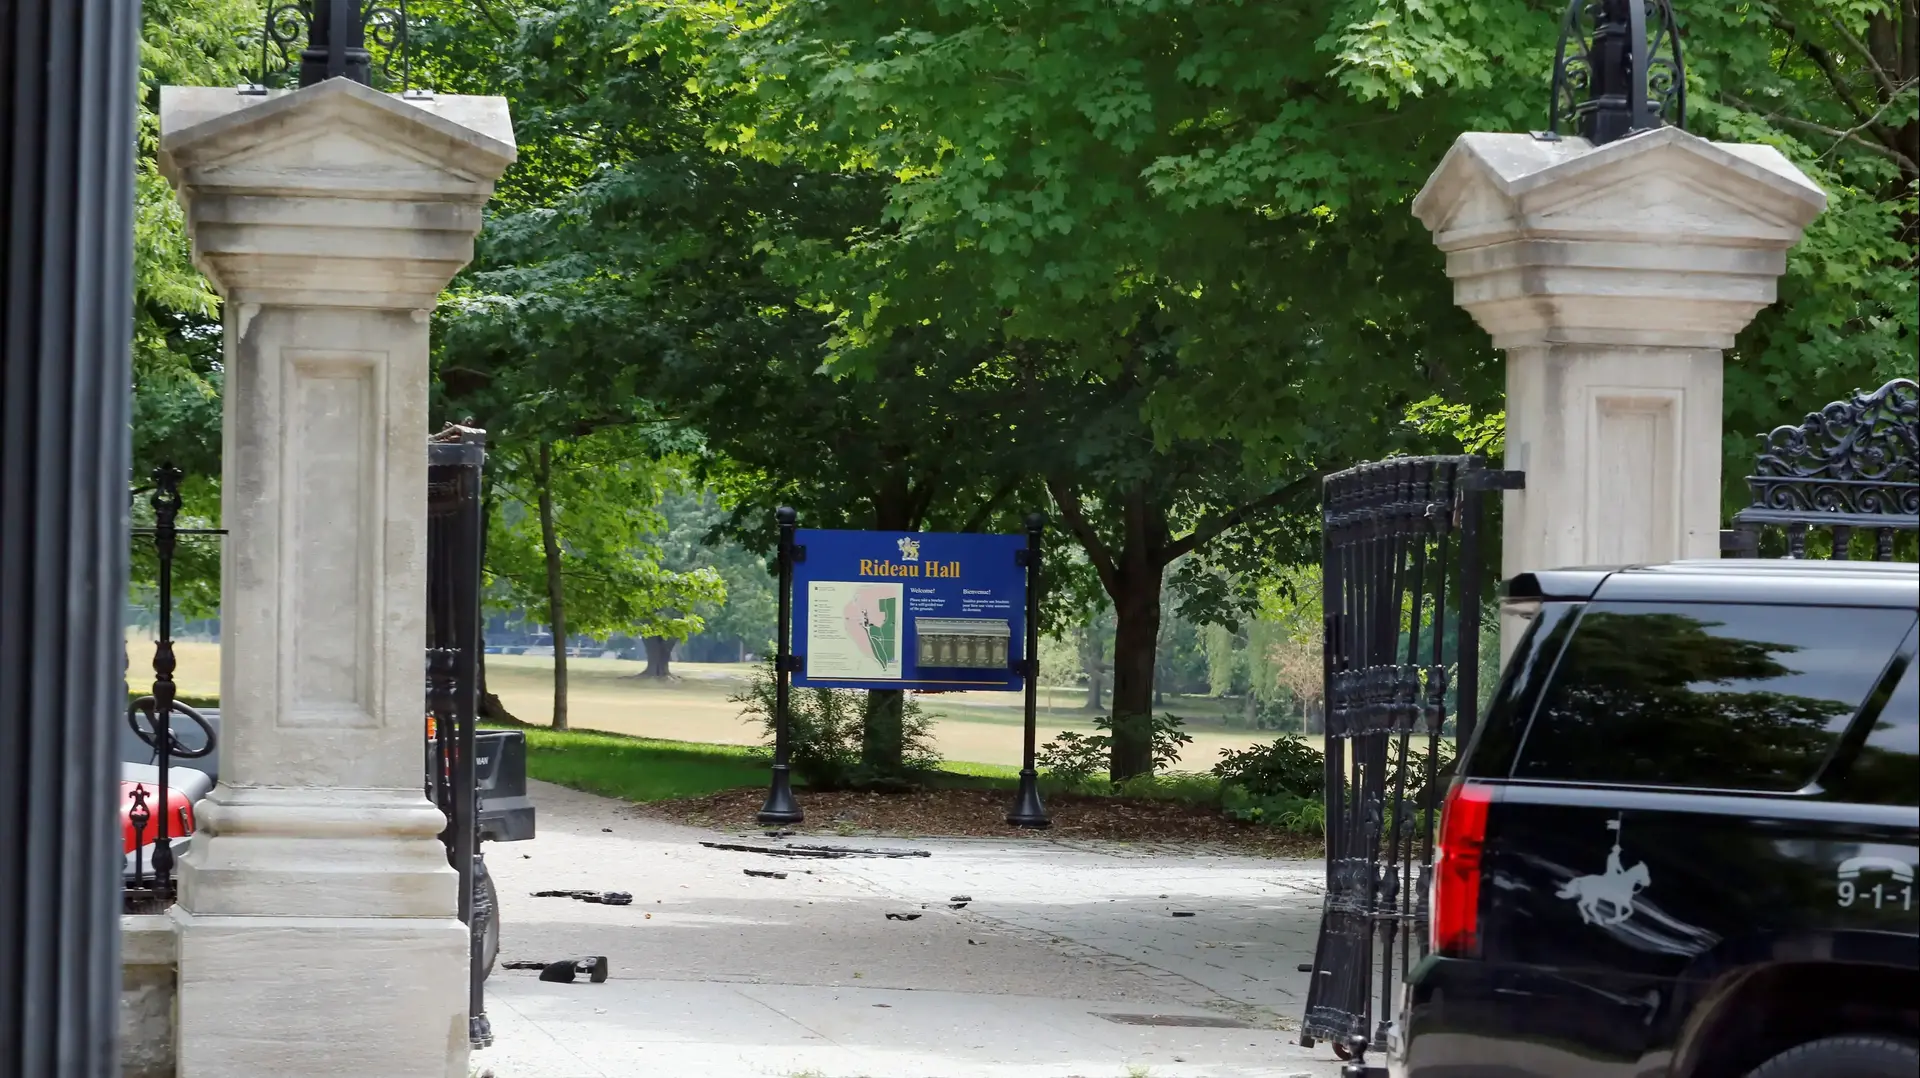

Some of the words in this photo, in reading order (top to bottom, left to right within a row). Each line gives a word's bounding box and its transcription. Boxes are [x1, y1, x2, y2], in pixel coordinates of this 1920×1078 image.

[859, 559, 919, 577] Rideau
[924, 560, 960, 578] Hall
[1837, 881, 1911, 911] 9-1-1
